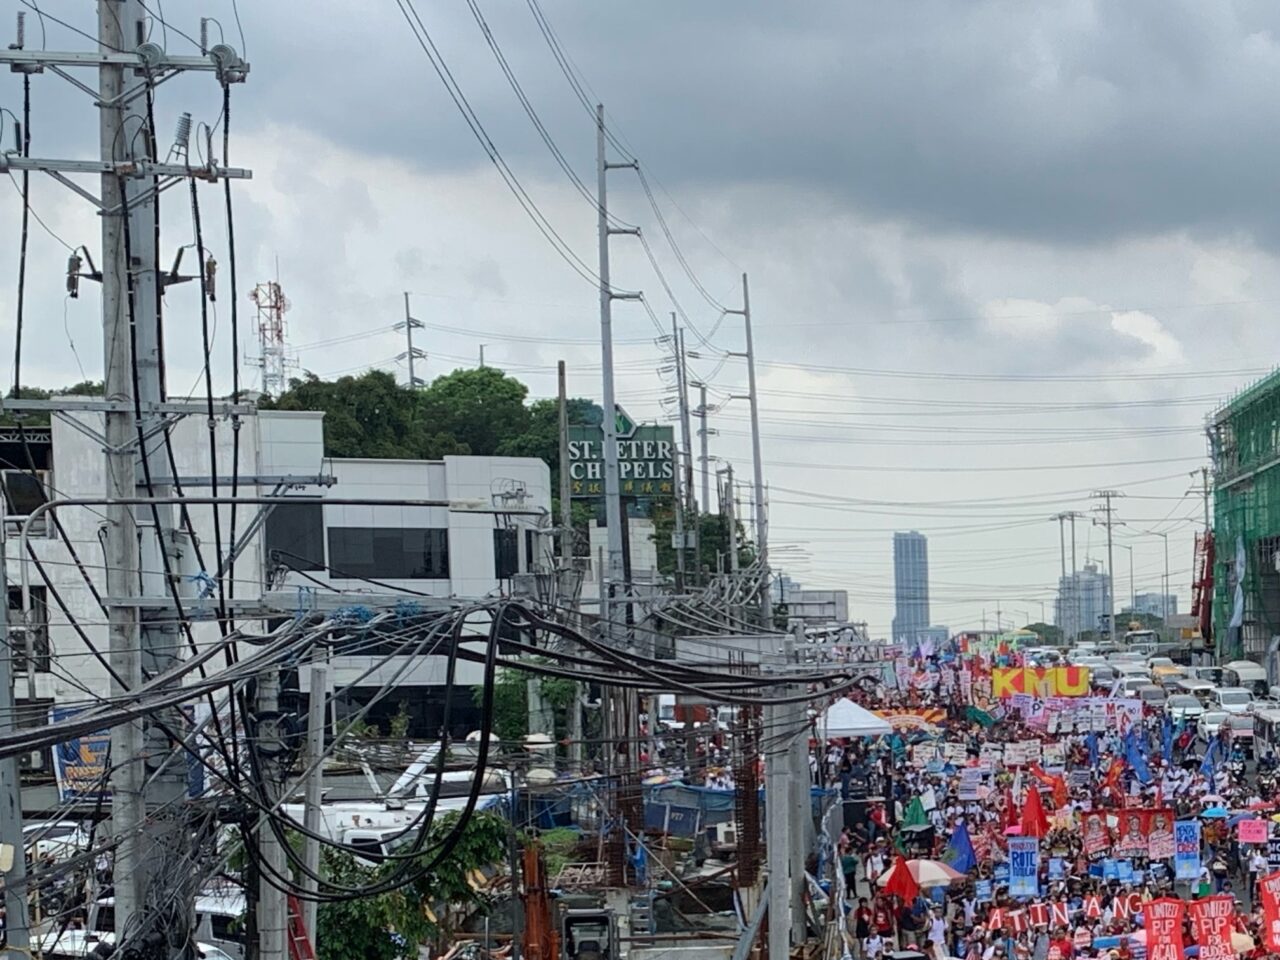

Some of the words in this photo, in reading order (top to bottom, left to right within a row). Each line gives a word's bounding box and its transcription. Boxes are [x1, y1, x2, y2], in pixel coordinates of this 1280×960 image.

[568, 440, 597, 459] ST.
[602, 440, 672, 459] ETER
[570, 461, 673, 479] CHPELS
[993, 668, 1088, 696] KMU
[1152, 919, 1176, 934] PUP
[1201, 918, 1227, 935] PUP
